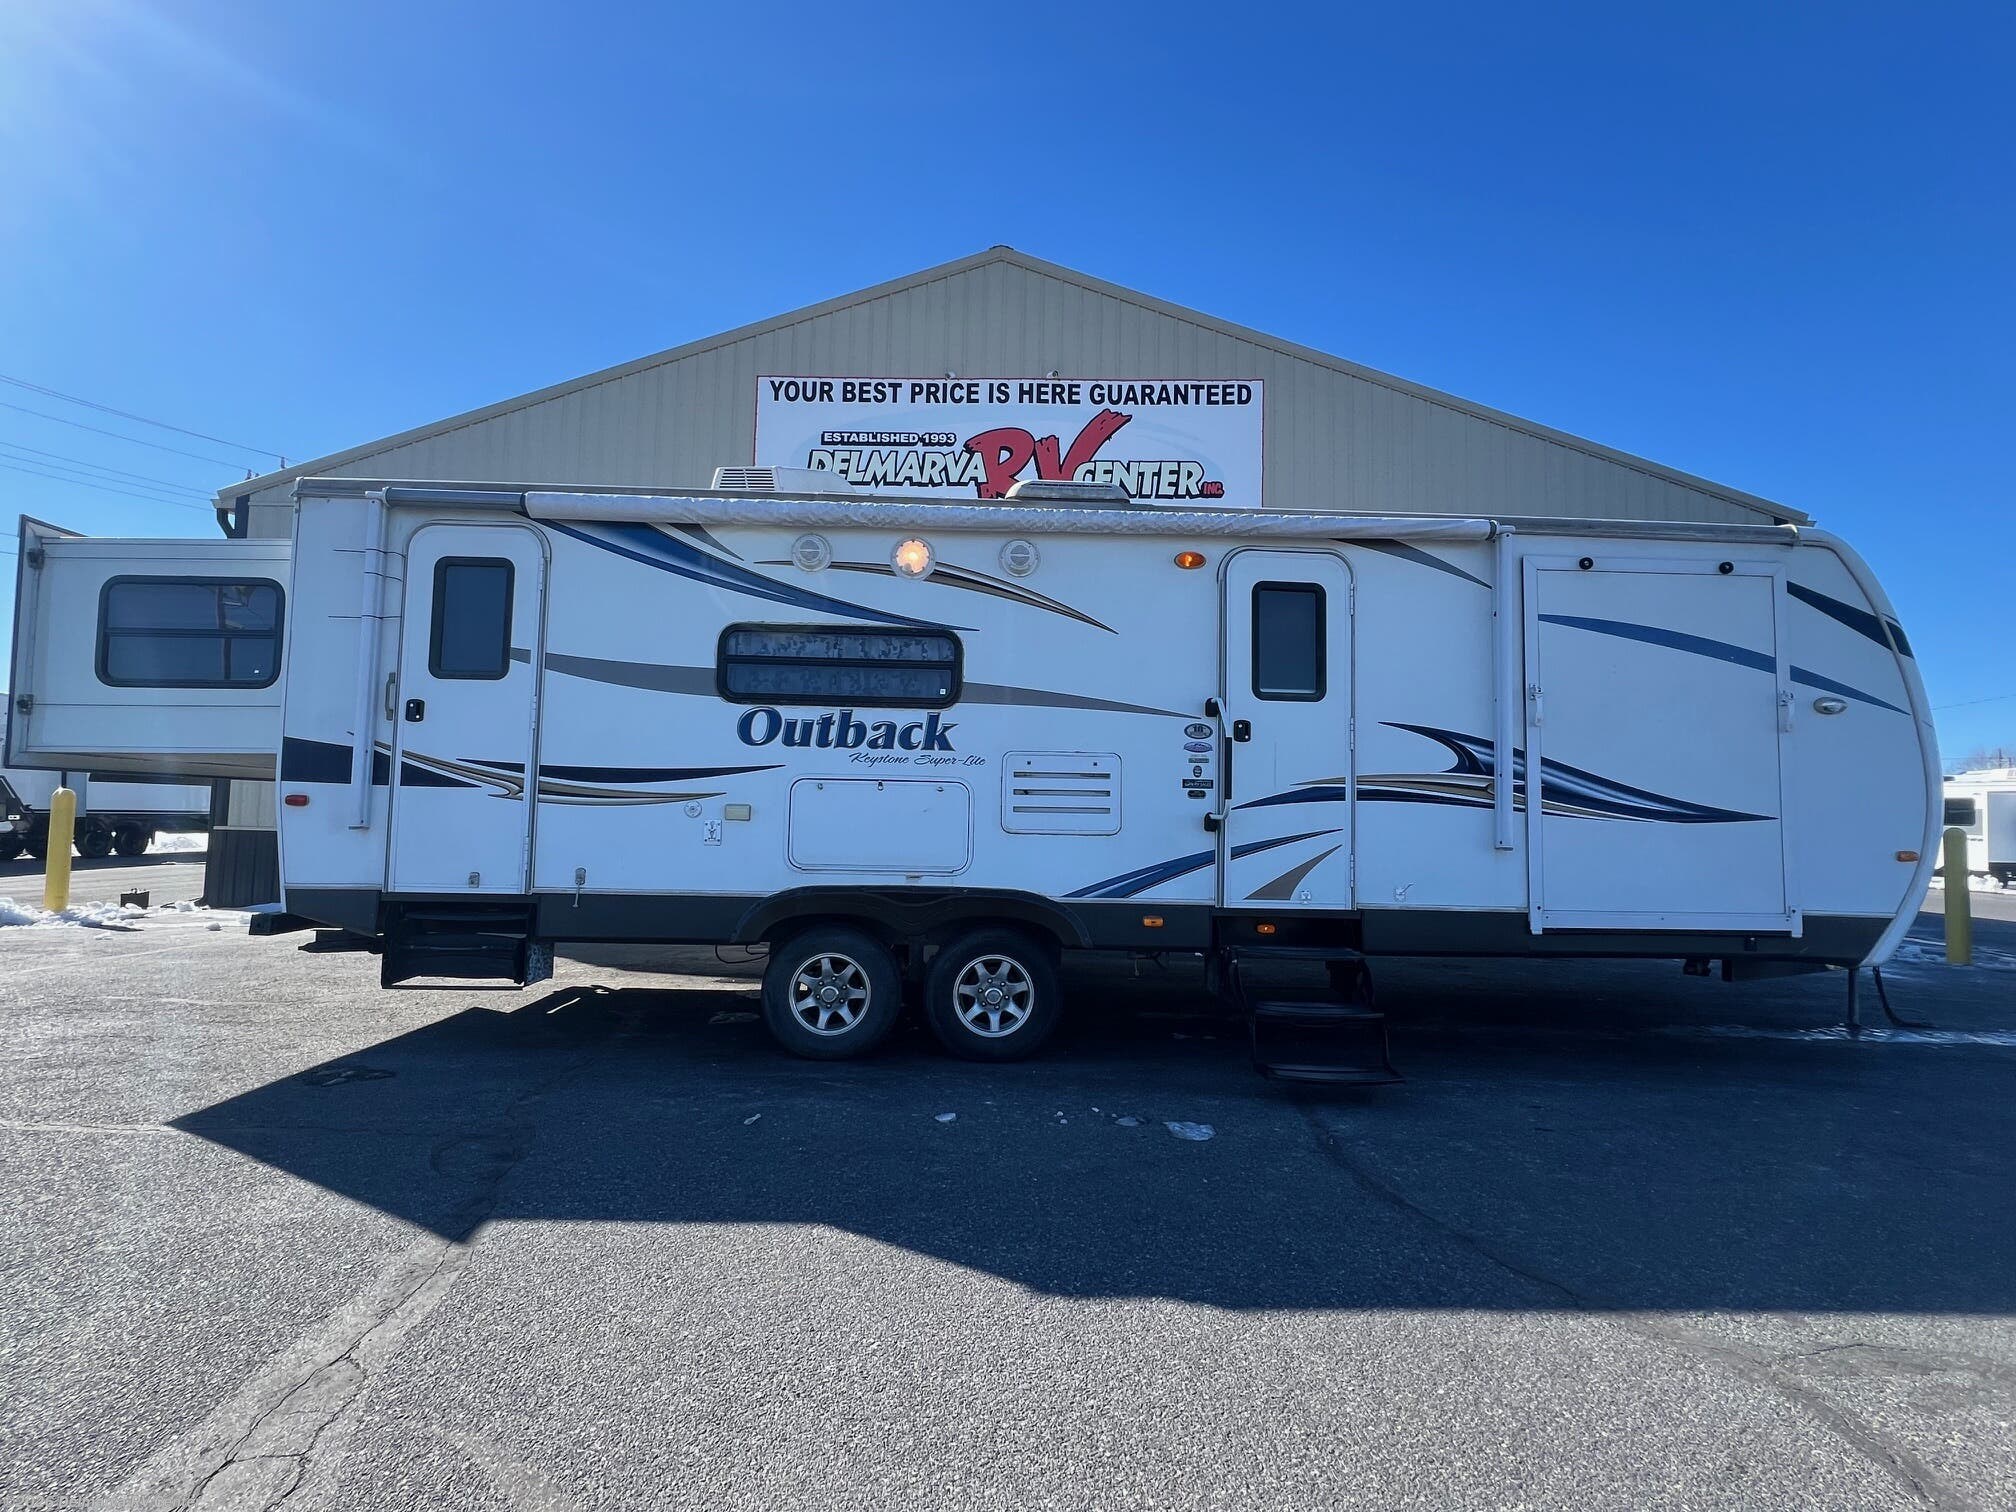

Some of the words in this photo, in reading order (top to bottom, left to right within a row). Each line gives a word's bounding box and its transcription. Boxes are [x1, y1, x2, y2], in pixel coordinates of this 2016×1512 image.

[769, 380, 834, 403] YOUR
[842, 381, 902, 404] BEST
[910, 382, 980, 404] PRICE
[988, 382, 1010, 404] IS
[1018, 383, 1081, 405] HERE
[1089, 383, 1252, 406] GUARANTEED
[823, 432, 919, 443] ESTABLISHED
[922, 432, 957, 444] 1993
[808, 449, 988, 487] DELMARVA
[963, 408, 1132, 499] RV
[1072, 460, 1204, 498] CENTER
[1202, 481, 1224, 498] INC.
[736, 706, 959, 751] Outback
[848, 752, 909, 768] Keystone
[914, 753, 986, 767] Super-Lite
